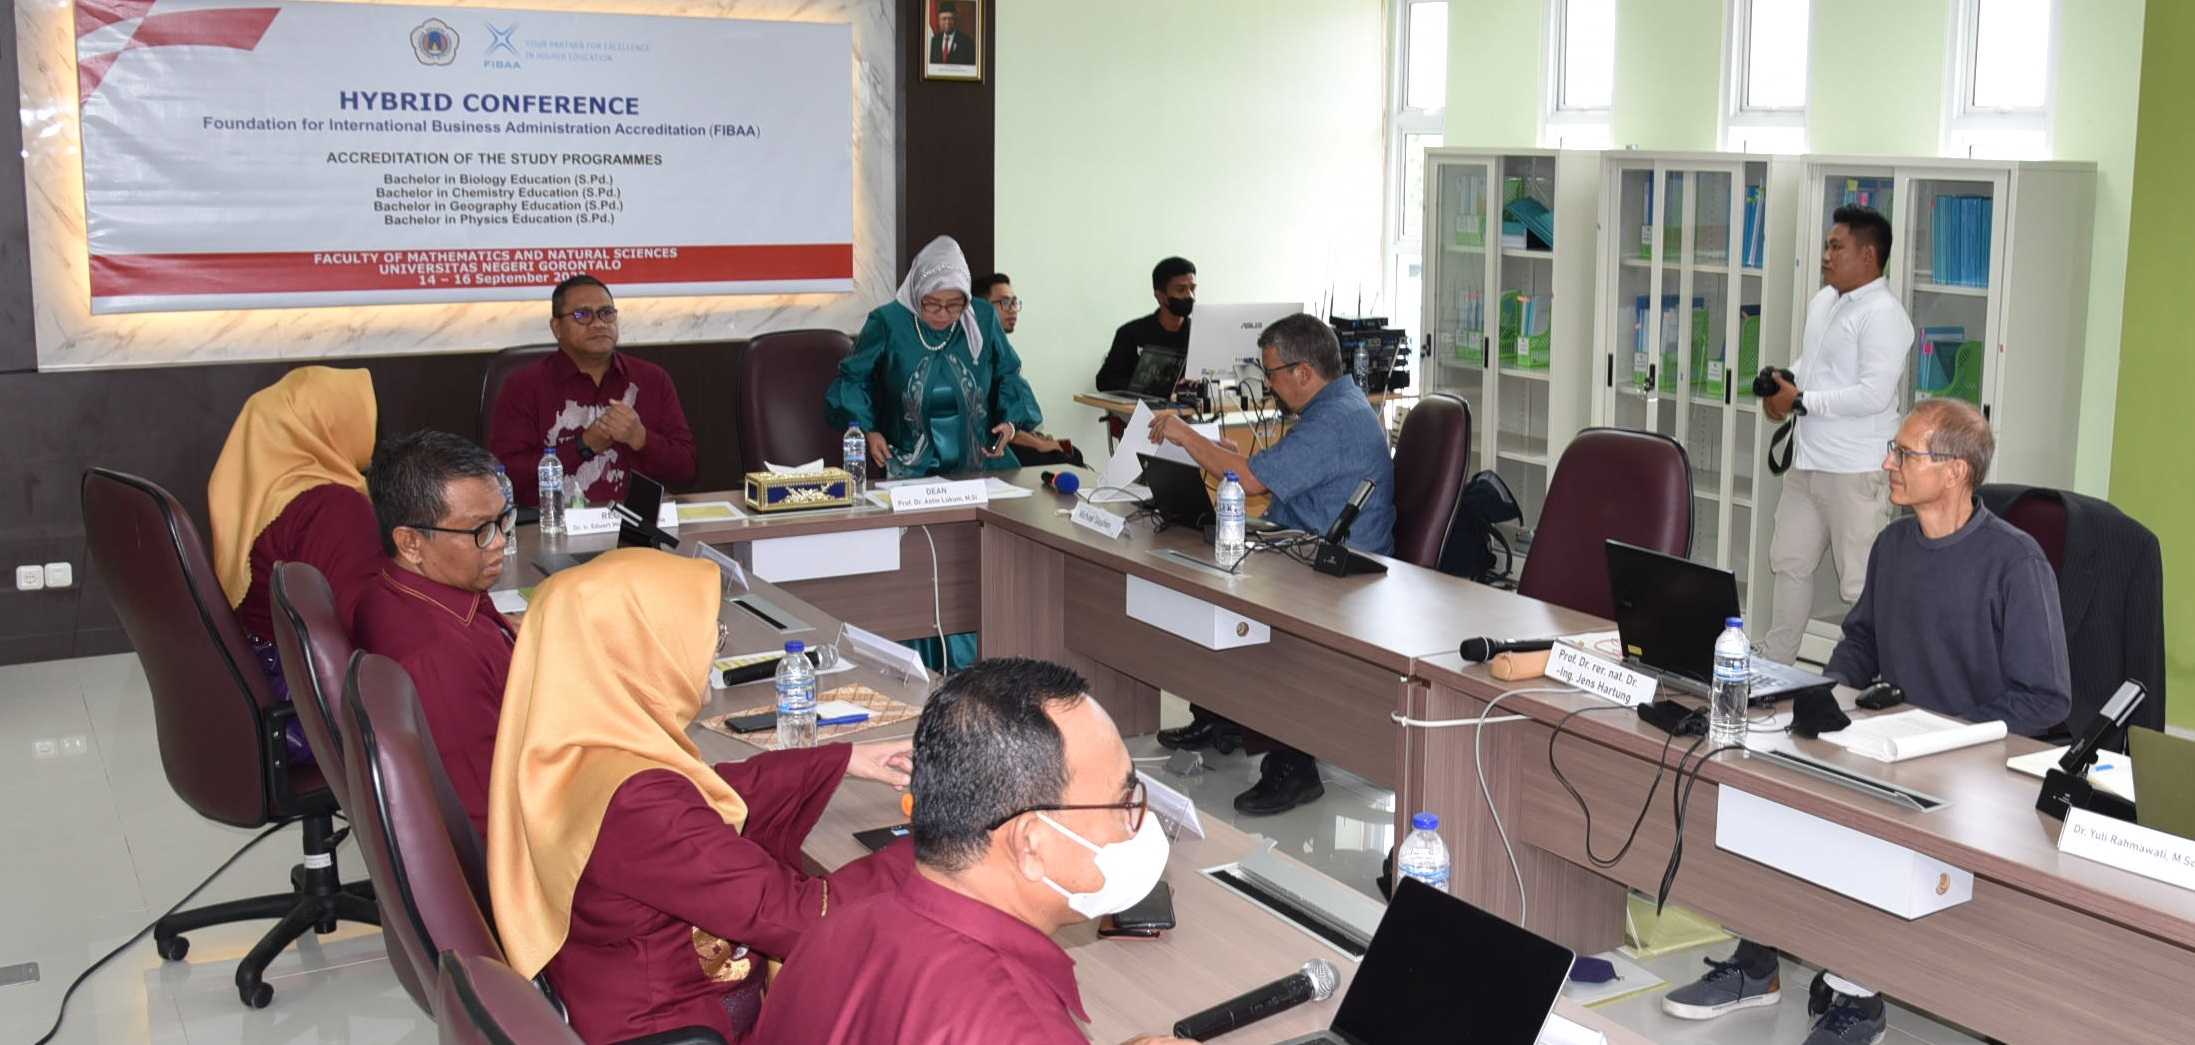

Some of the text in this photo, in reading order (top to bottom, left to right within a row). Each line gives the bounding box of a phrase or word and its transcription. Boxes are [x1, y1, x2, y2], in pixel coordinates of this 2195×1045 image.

[484, 60, 521, 69] FIBAA
[340, 91, 640, 115] HYBRID CONFERENCE
[203, 117, 761, 139] Foundation for International Business Administration Accreditation (FIBAA)
[326, 152, 663, 166] ACCREDITATION OF THE STUDY PROGRAMMES
[384, 173, 614, 187] Bachelor in Biology Education (S.Pd.)
[376, 187, 622, 201] Bachelor in Chemistry Education (S.Pd.)
[374, 200, 624, 214] Bachelor in Geography Education (S.Pd.)
[384, 213, 615, 227] Bachelor in Physics Education (S.Pd.)
[314, 247, 678, 264] FACULTY OF MATHEMATICS AND NATURAL SCIENCES
[379, 260, 622, 275] UNIVERSITAS NEGERI GORONTALO
[419, 275, 436, 285] 14
[455, 274, 471, 284] 16
[475, 272, 549, 286] September
[926, 487, 947, 496] DEAN
[1559, 649, 1639, 688] Prof. Dr. rer. nat. Dr.
[1556, 667, 1631, 704] -Ing. Jens Hartung
[2073, 824, 2087, 835] Dr.
[2090, 829, 2107, 841] Yuli
[2110, 834, 2169, 861] Rahmawati,
